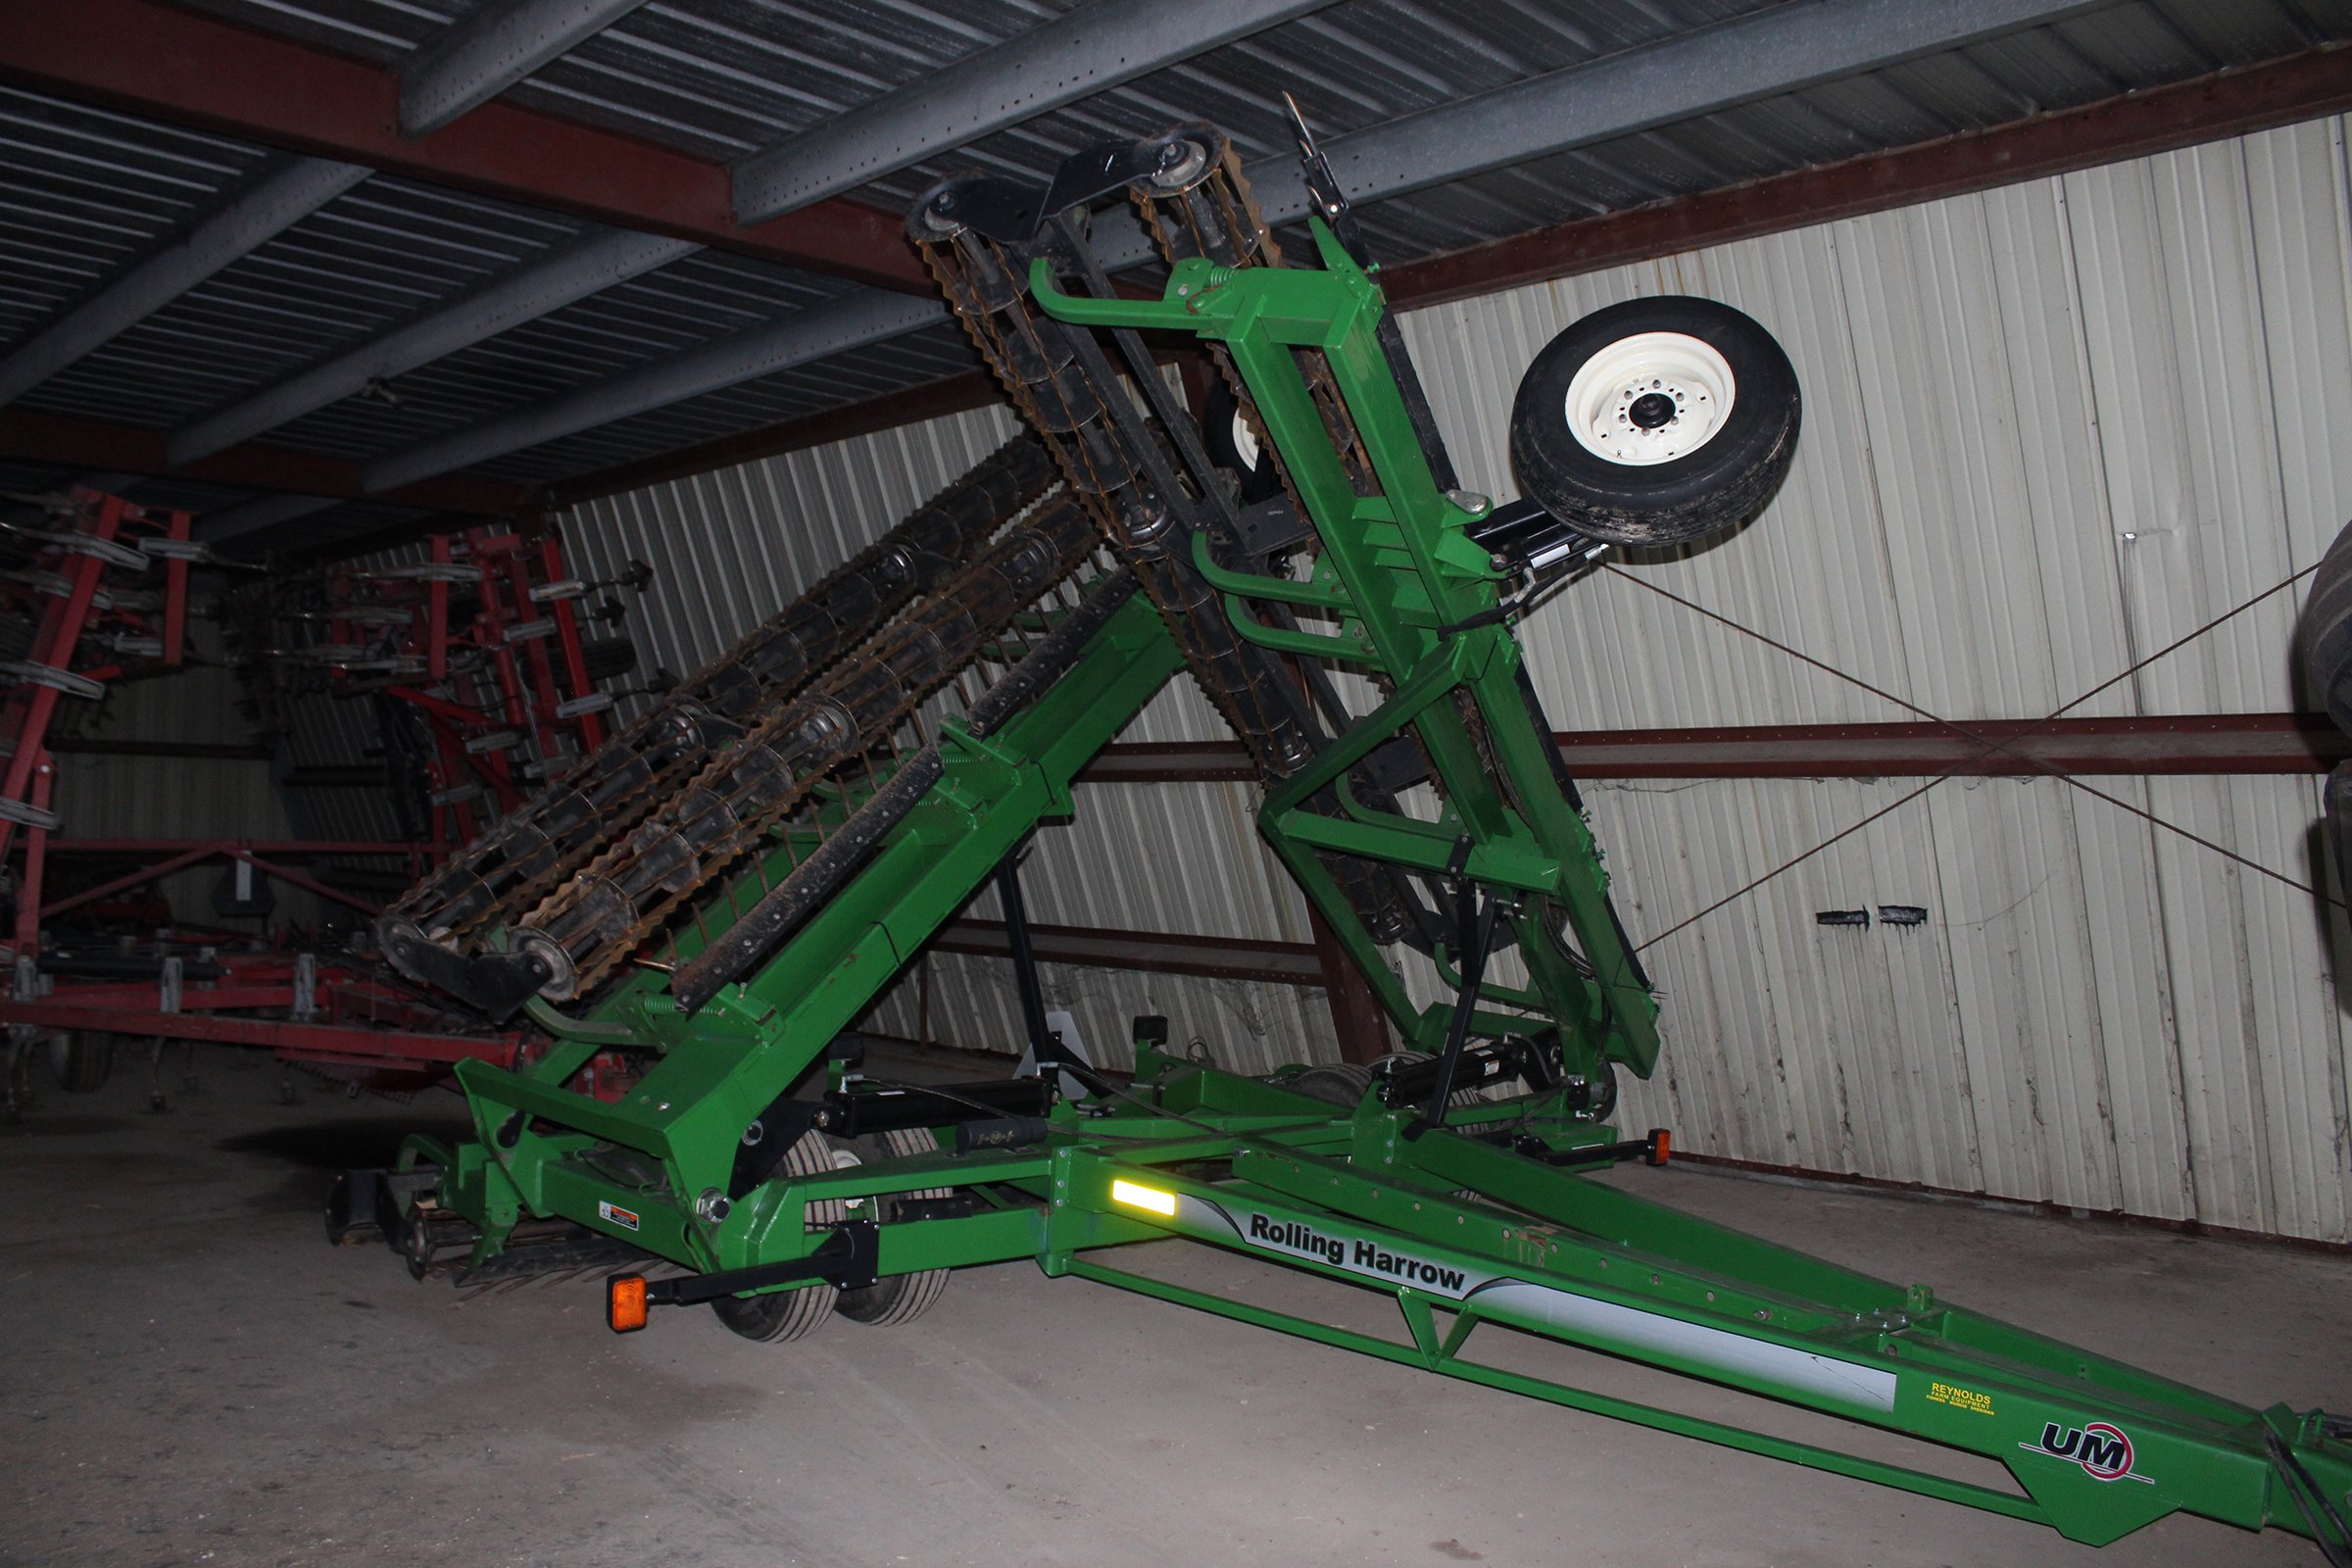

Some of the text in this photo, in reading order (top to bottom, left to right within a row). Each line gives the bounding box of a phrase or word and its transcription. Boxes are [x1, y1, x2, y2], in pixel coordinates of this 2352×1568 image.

[1250, 1213, 1465, 1292] Rolling Harrow
[1931, 1391, 1989, 1409] FARM EQUIPMENT
[1932, 1383, 1991, 1404] REYNOLDS
[2041, 1422, 2127, 1470] UM
